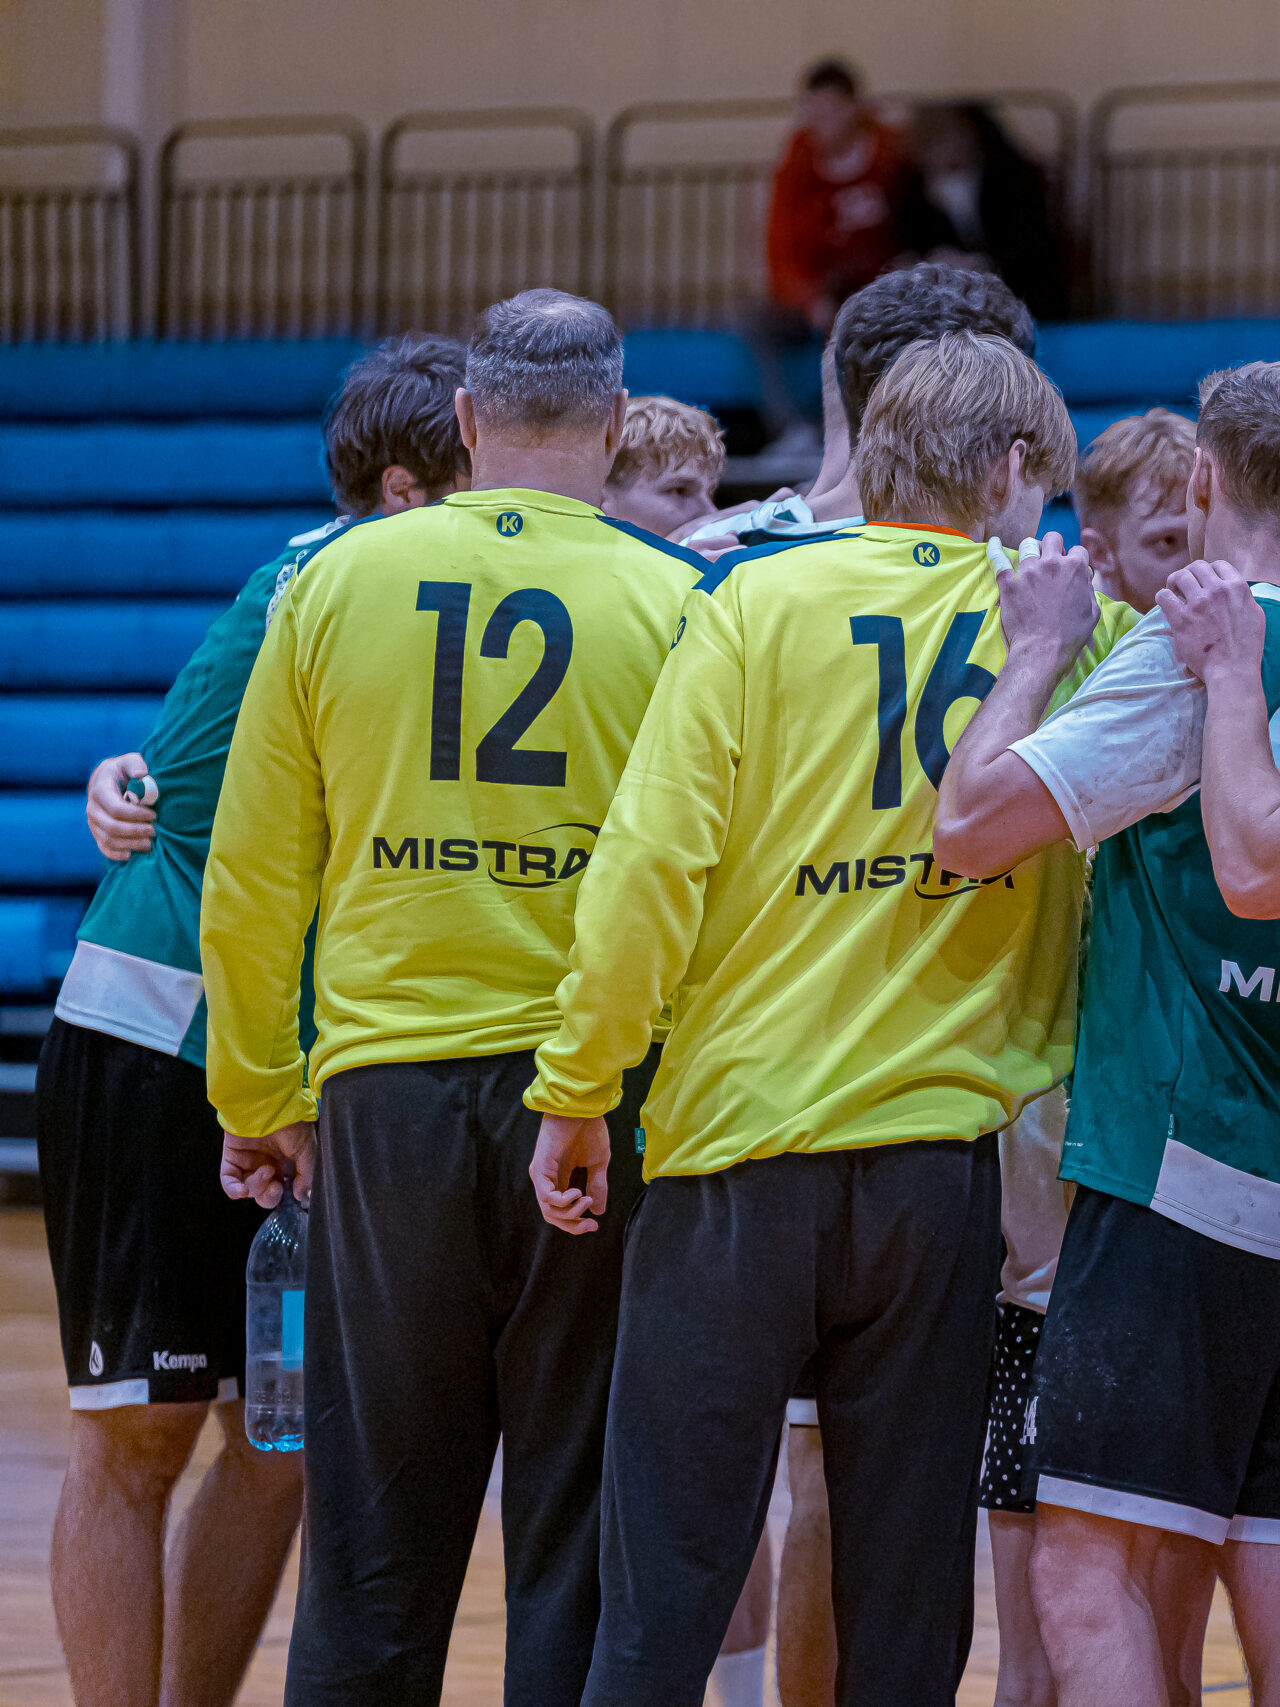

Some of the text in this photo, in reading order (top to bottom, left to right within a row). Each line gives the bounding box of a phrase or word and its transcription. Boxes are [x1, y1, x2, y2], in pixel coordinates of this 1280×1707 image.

[416, 581, 573, 786] 12
[849, 609, 997, 809] 16
[372, 828, 599, 886] MISTRA
[795, 853, 1014, 899] MIST
